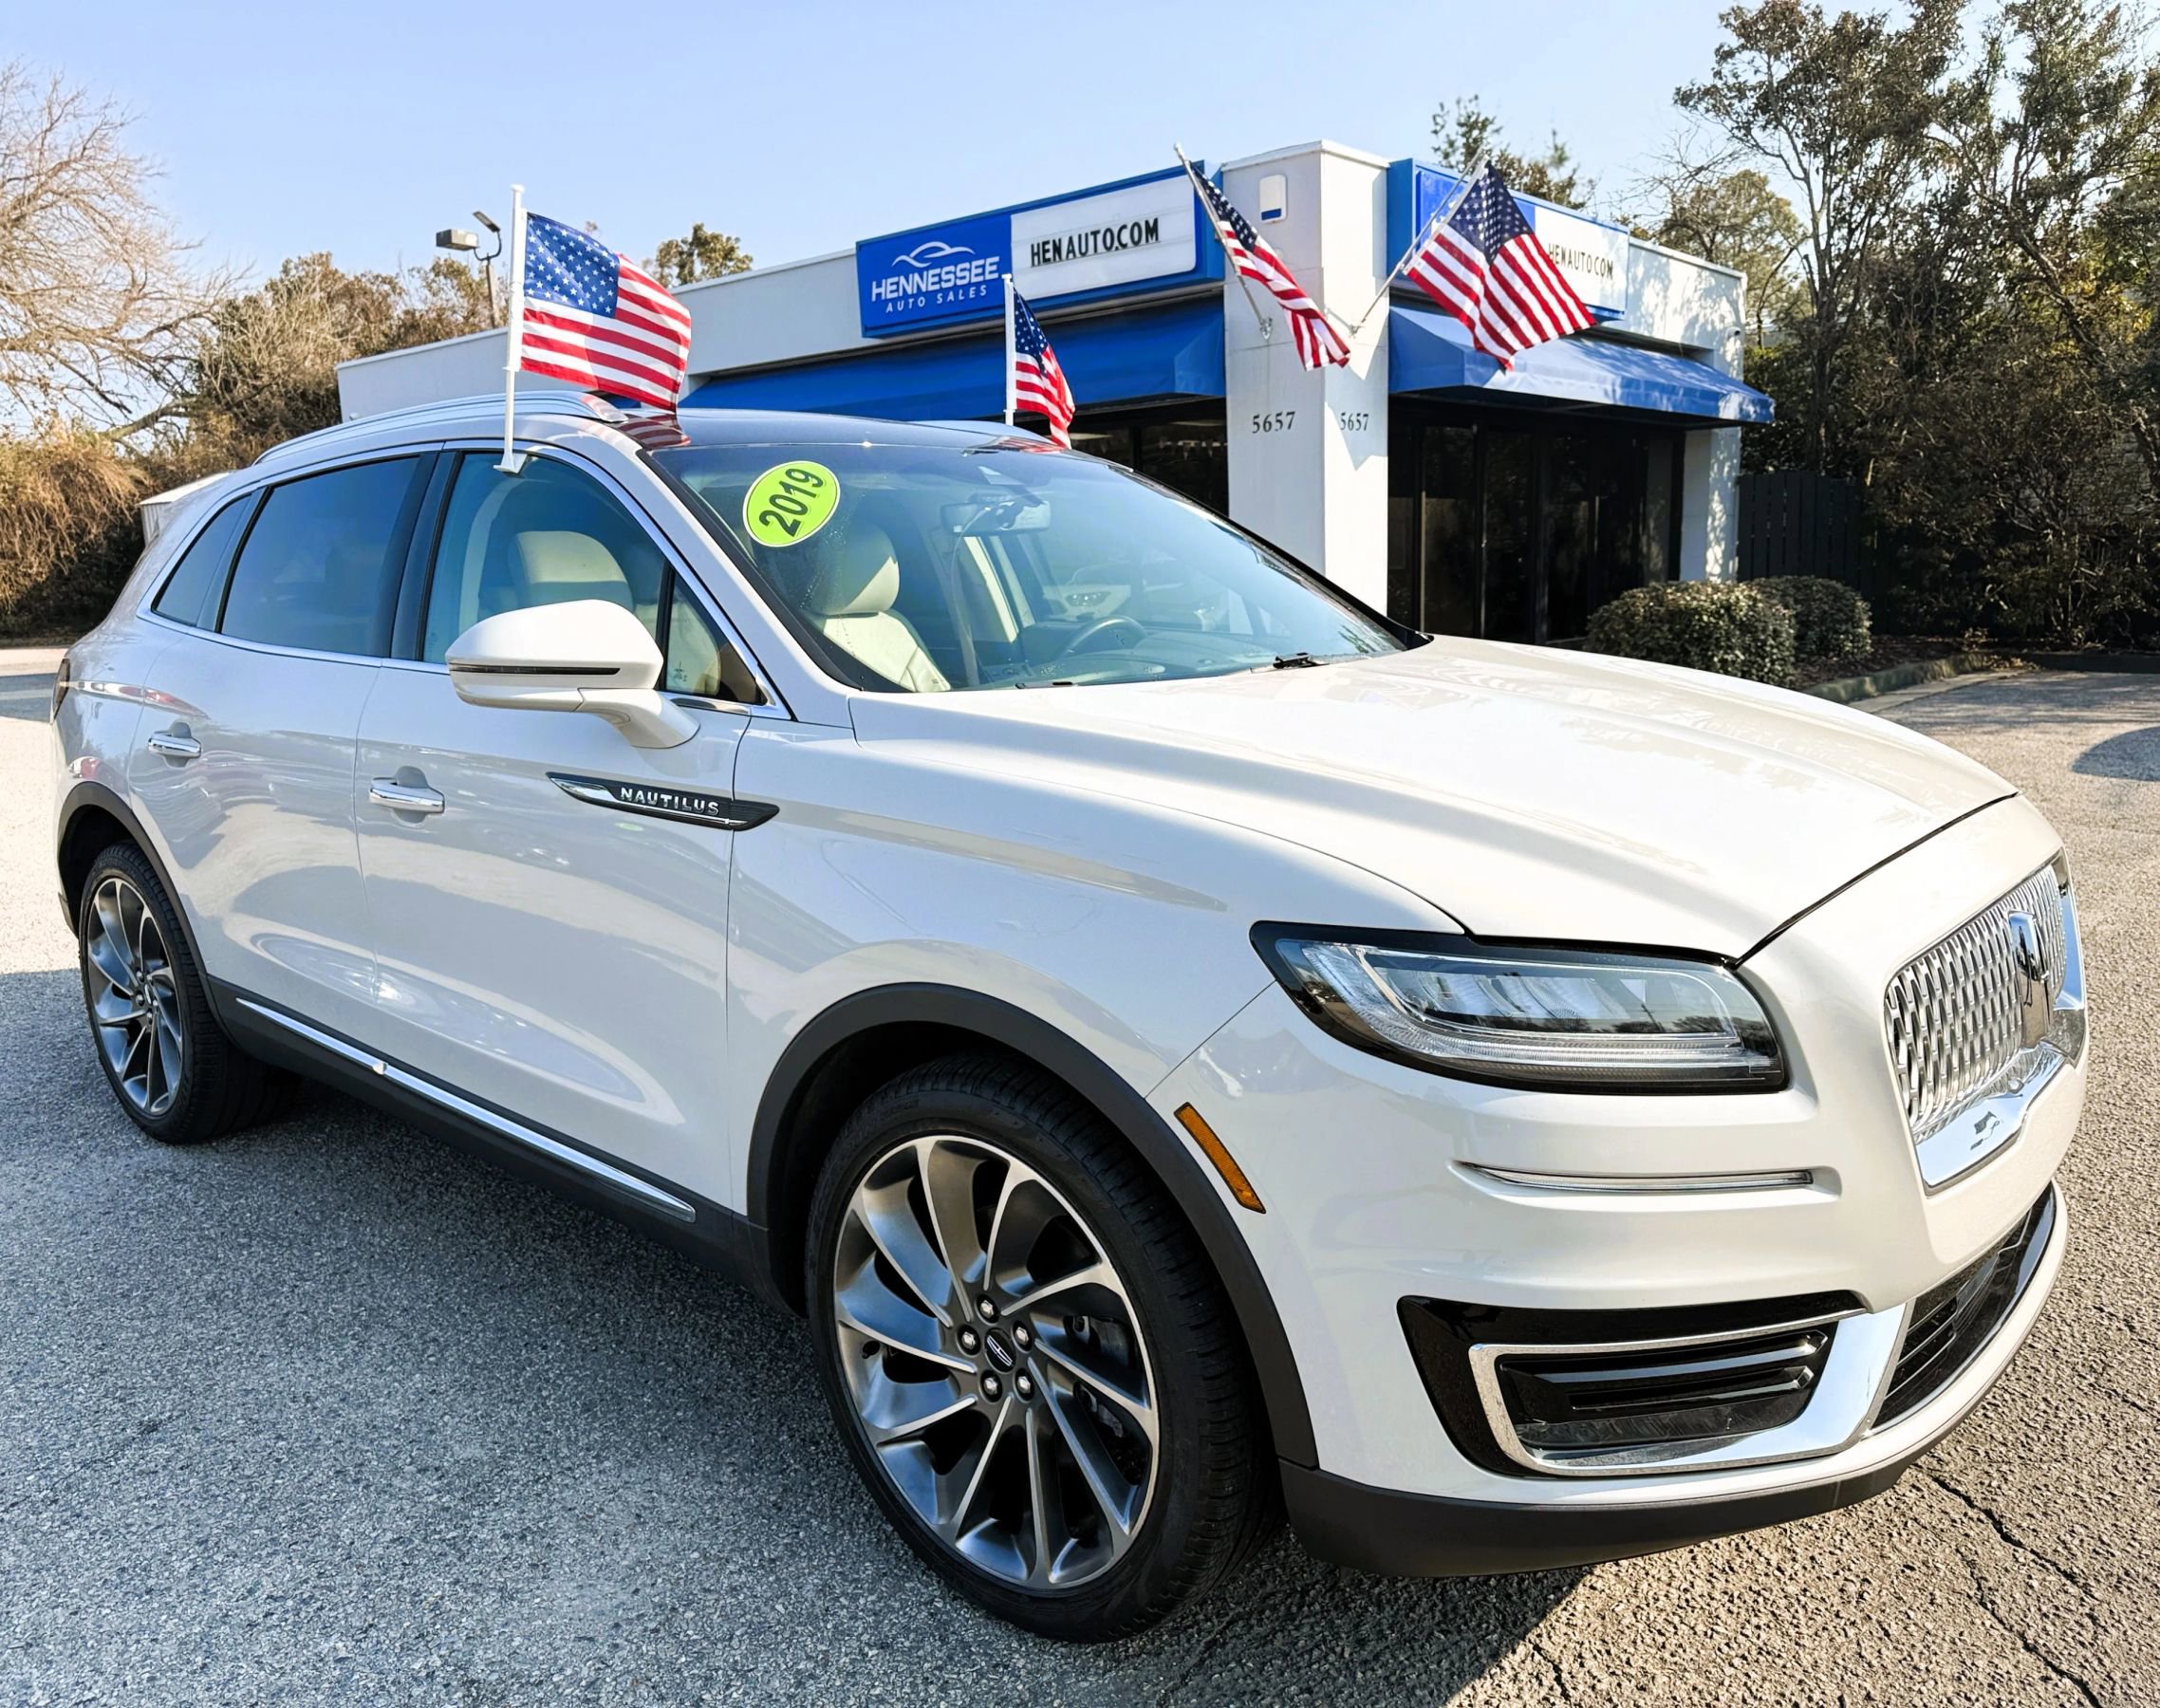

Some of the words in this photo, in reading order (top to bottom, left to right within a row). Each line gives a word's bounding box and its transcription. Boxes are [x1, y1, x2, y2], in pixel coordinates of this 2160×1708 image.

[1031, 217, 1159, 267] HENAUTO.COM
[871, 256, 1000, 302] HENNESSEE
[885, 296, 925, 314] AUTO
[936, 285, 987, 305] SALES
[1252, 410, 1295, 434] 5657
[1340, 412, 1369, 431] 5657
[758, 468, 824, 538] 2019
[620, 787, 719, 816] NAUTILUS
